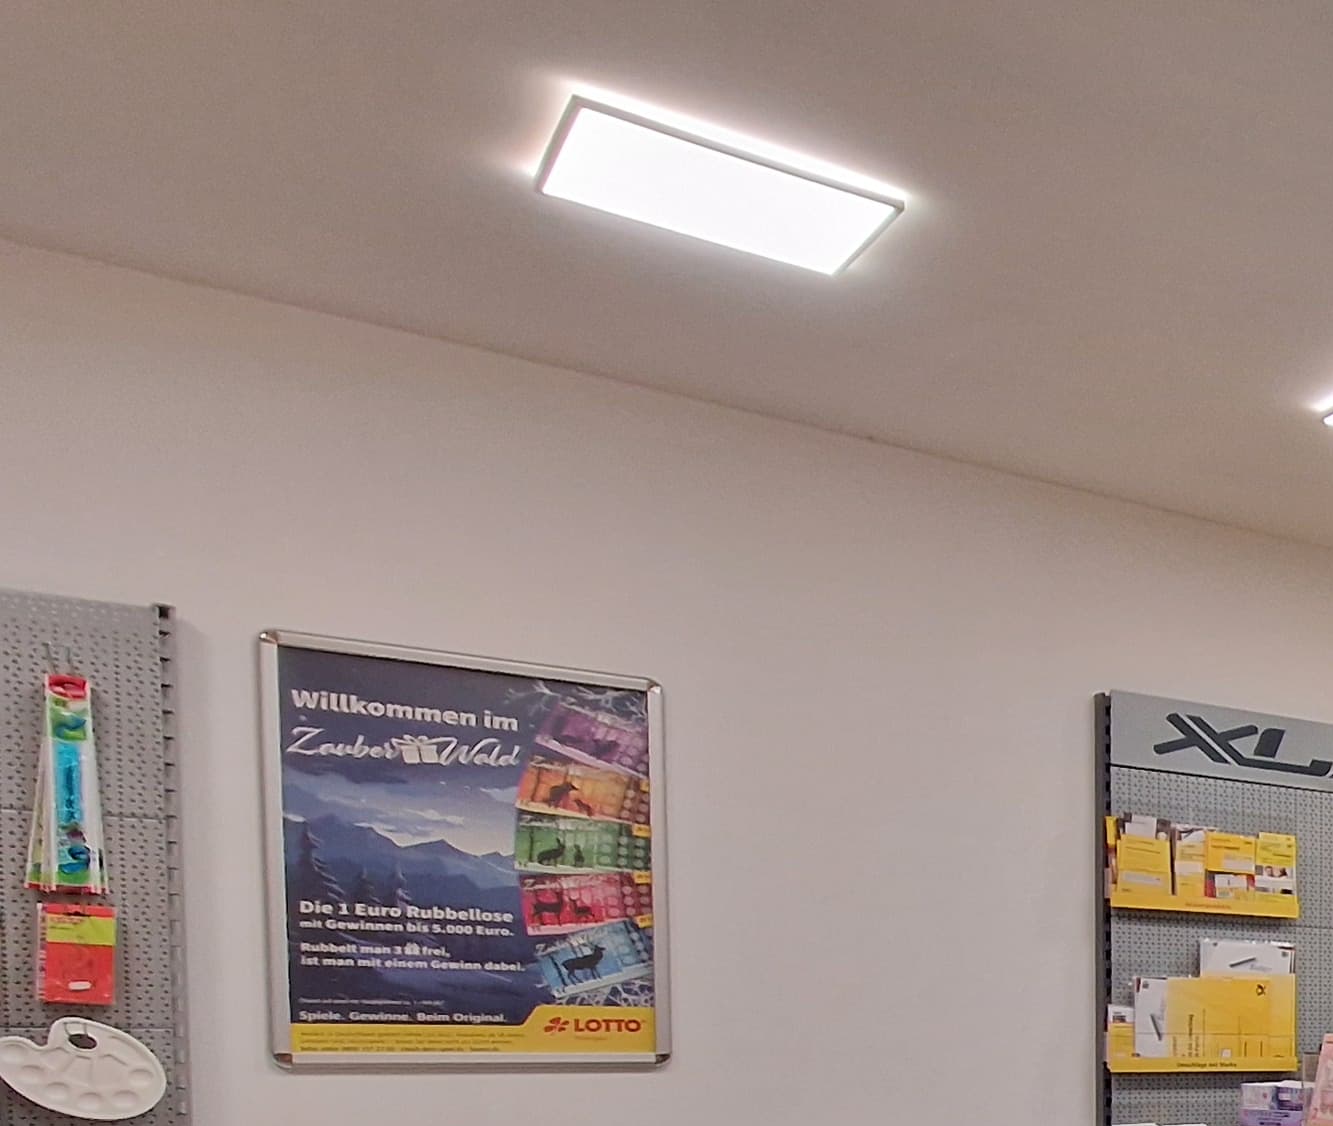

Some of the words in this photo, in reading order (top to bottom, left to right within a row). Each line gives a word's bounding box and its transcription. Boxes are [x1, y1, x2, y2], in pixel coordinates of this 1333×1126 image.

[291, 689, 477, 728] Willkommen
[484, 710, 519, 732] im
[287, 726, 398, 760] Zauber
[438, 737, 520, 767] Wald
[300, 900, 334, 915] Die
[339, 903, 350, 916] 1
[355, 903, 402, 918] Euro
[406, 905, 514, 924] Rubbellose
[300, 919, 323, 929] mit
[325, 919, 404, 932] Gewinnen
[407, 921, 429, 933] bis
[432, 923, 473, 936] 5.000
[475, 926, 515, 937] Euro.
[300, 942, 358, 954] Rubbelt
[360, 945, 391, 955] man
[394, 945, 402, 955] 3
[301, 956, 320, 966] ist
[322, 957, 355, 967] man
[357, 957, 382, 968] mit
[384, 958, 428, 969] einem
[430, 959, 482, 971] Gewinn
[484, 961, 526, 973] dabei.
[299, 1010, 345, 1022] Spiele.
[349, 1011, 412, 1021] Gewinne.
[416, 1012, 450, 1022] Beim
[573, 1018, 642, 1033] LOTTO
